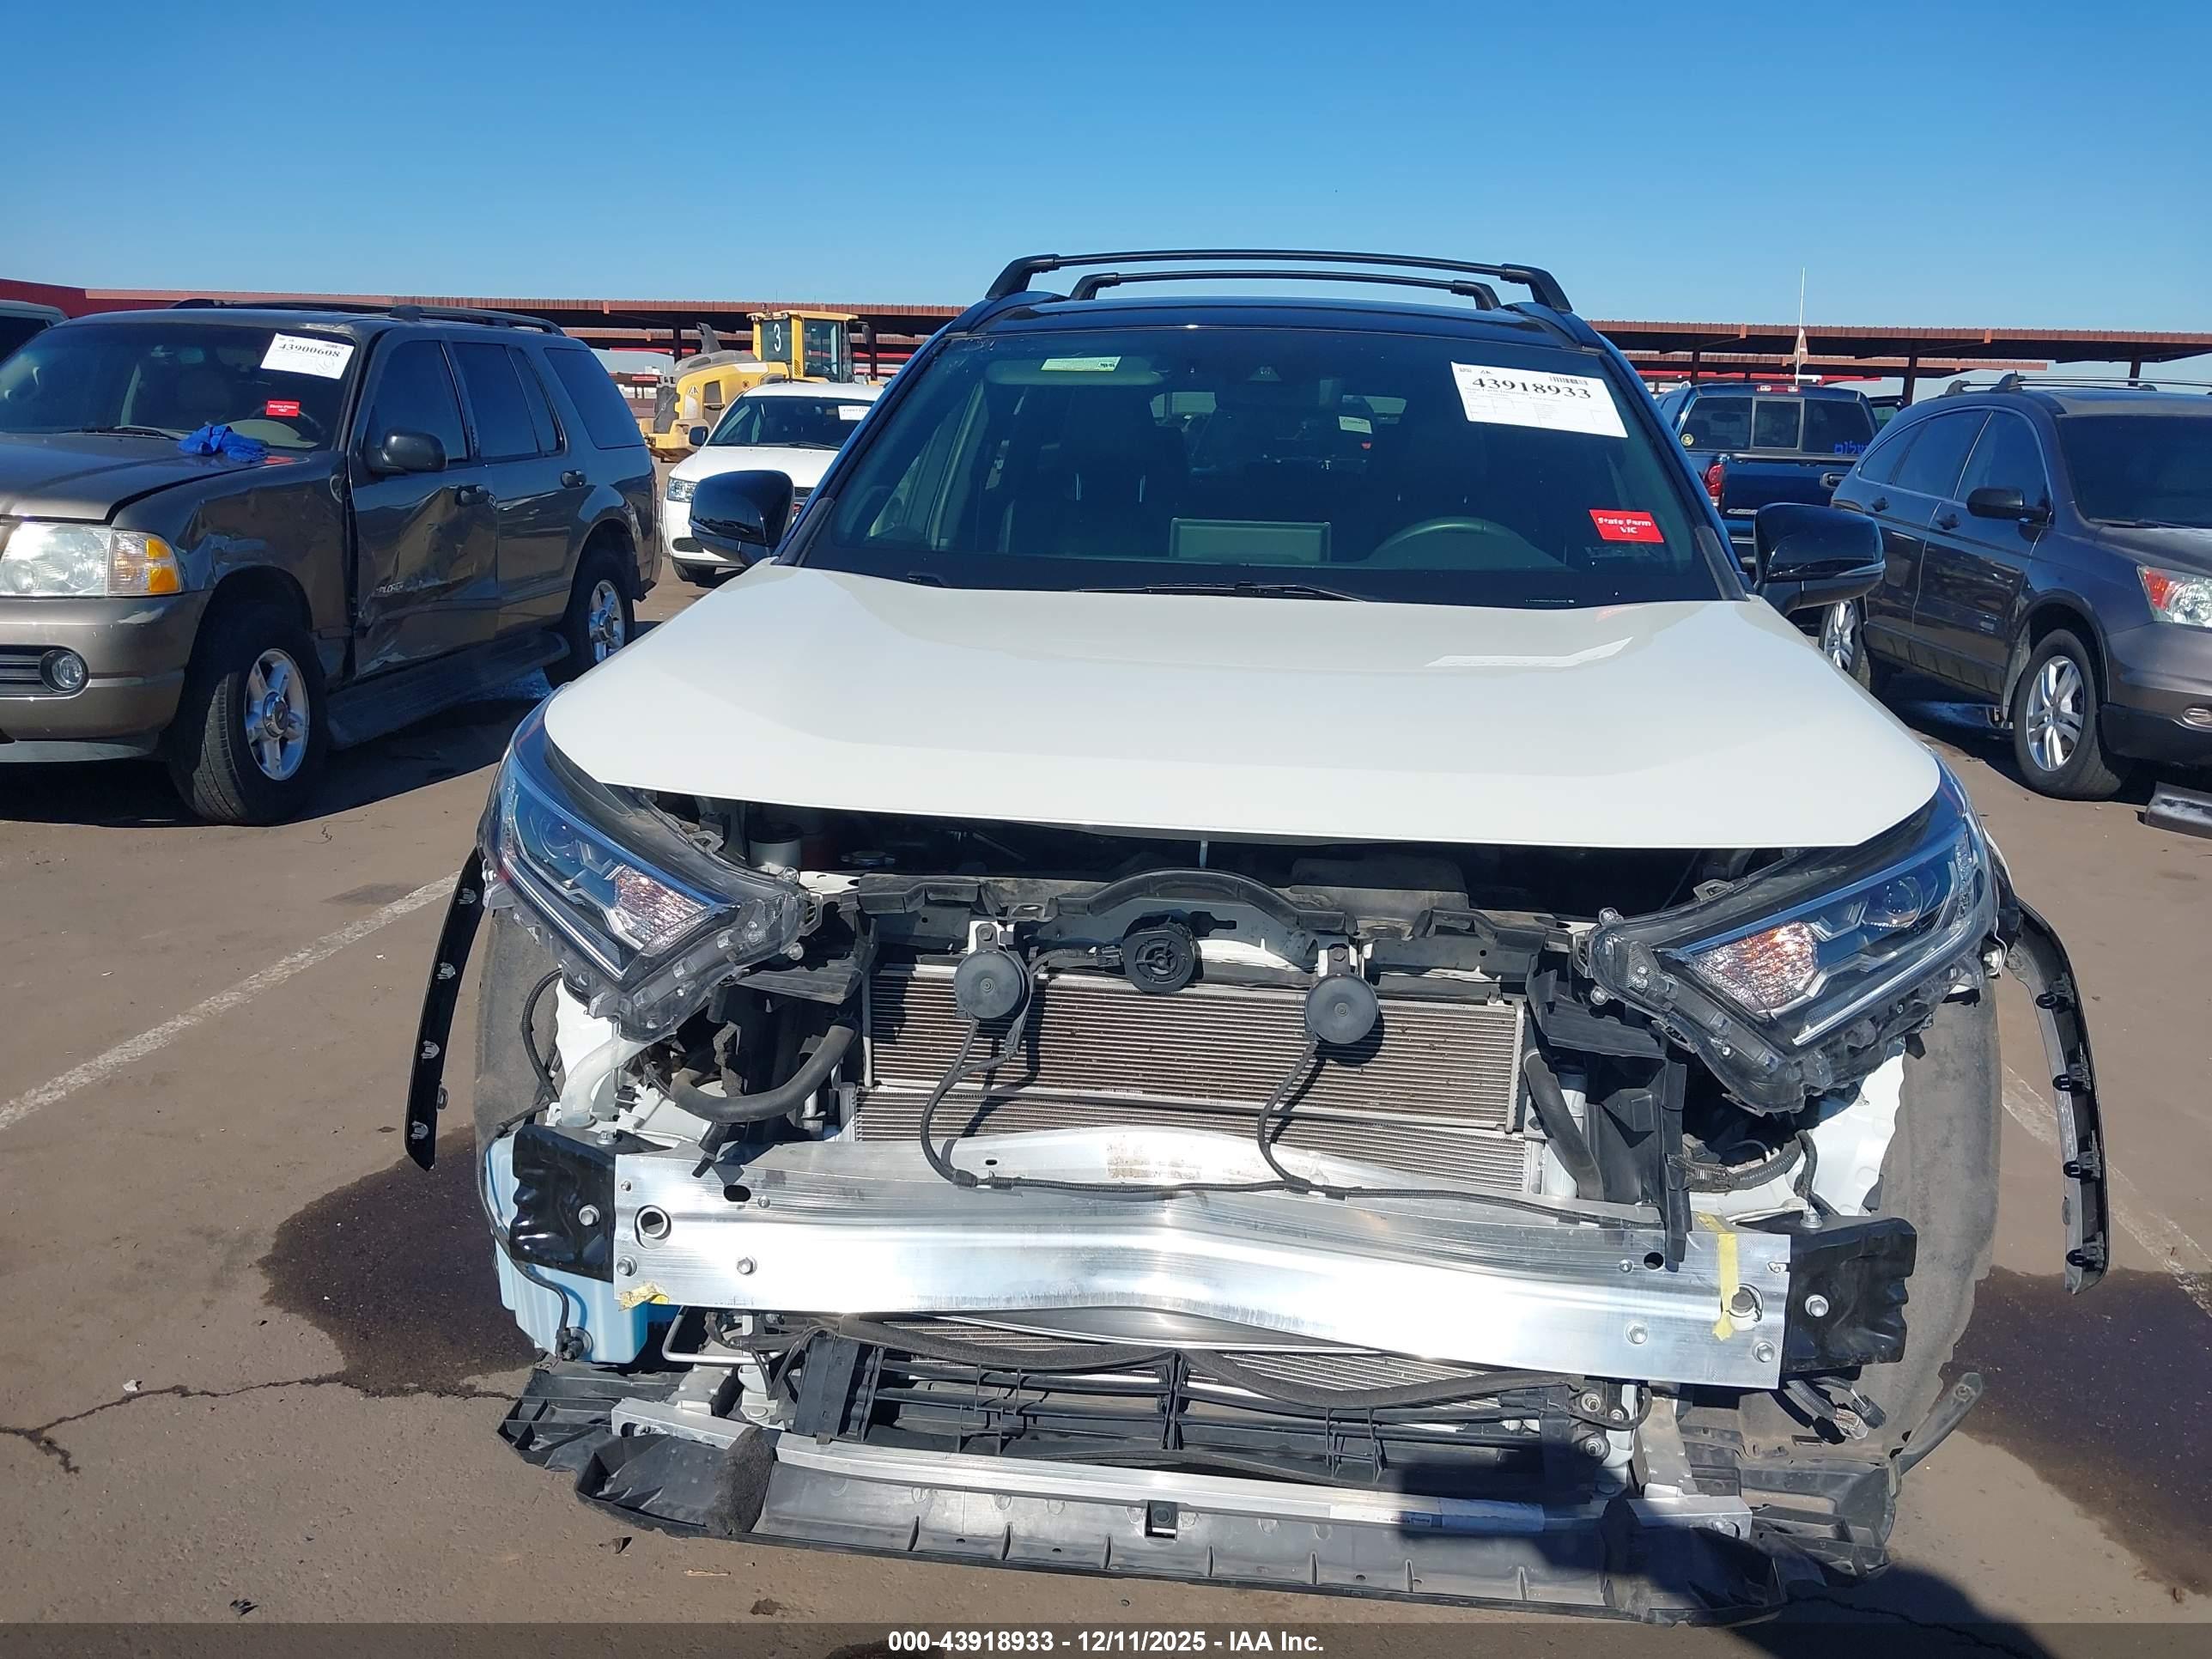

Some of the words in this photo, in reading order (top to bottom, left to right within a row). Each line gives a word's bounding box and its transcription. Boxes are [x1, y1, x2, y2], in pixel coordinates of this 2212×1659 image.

[774, 324, 781, 352] 3
[278, 343, 341, 357] 43900608
[1472, 377, 1592, 399] 43918933
[1597, 517, 1624, 526] State
[1626, 519, 1652, 527] Farm
